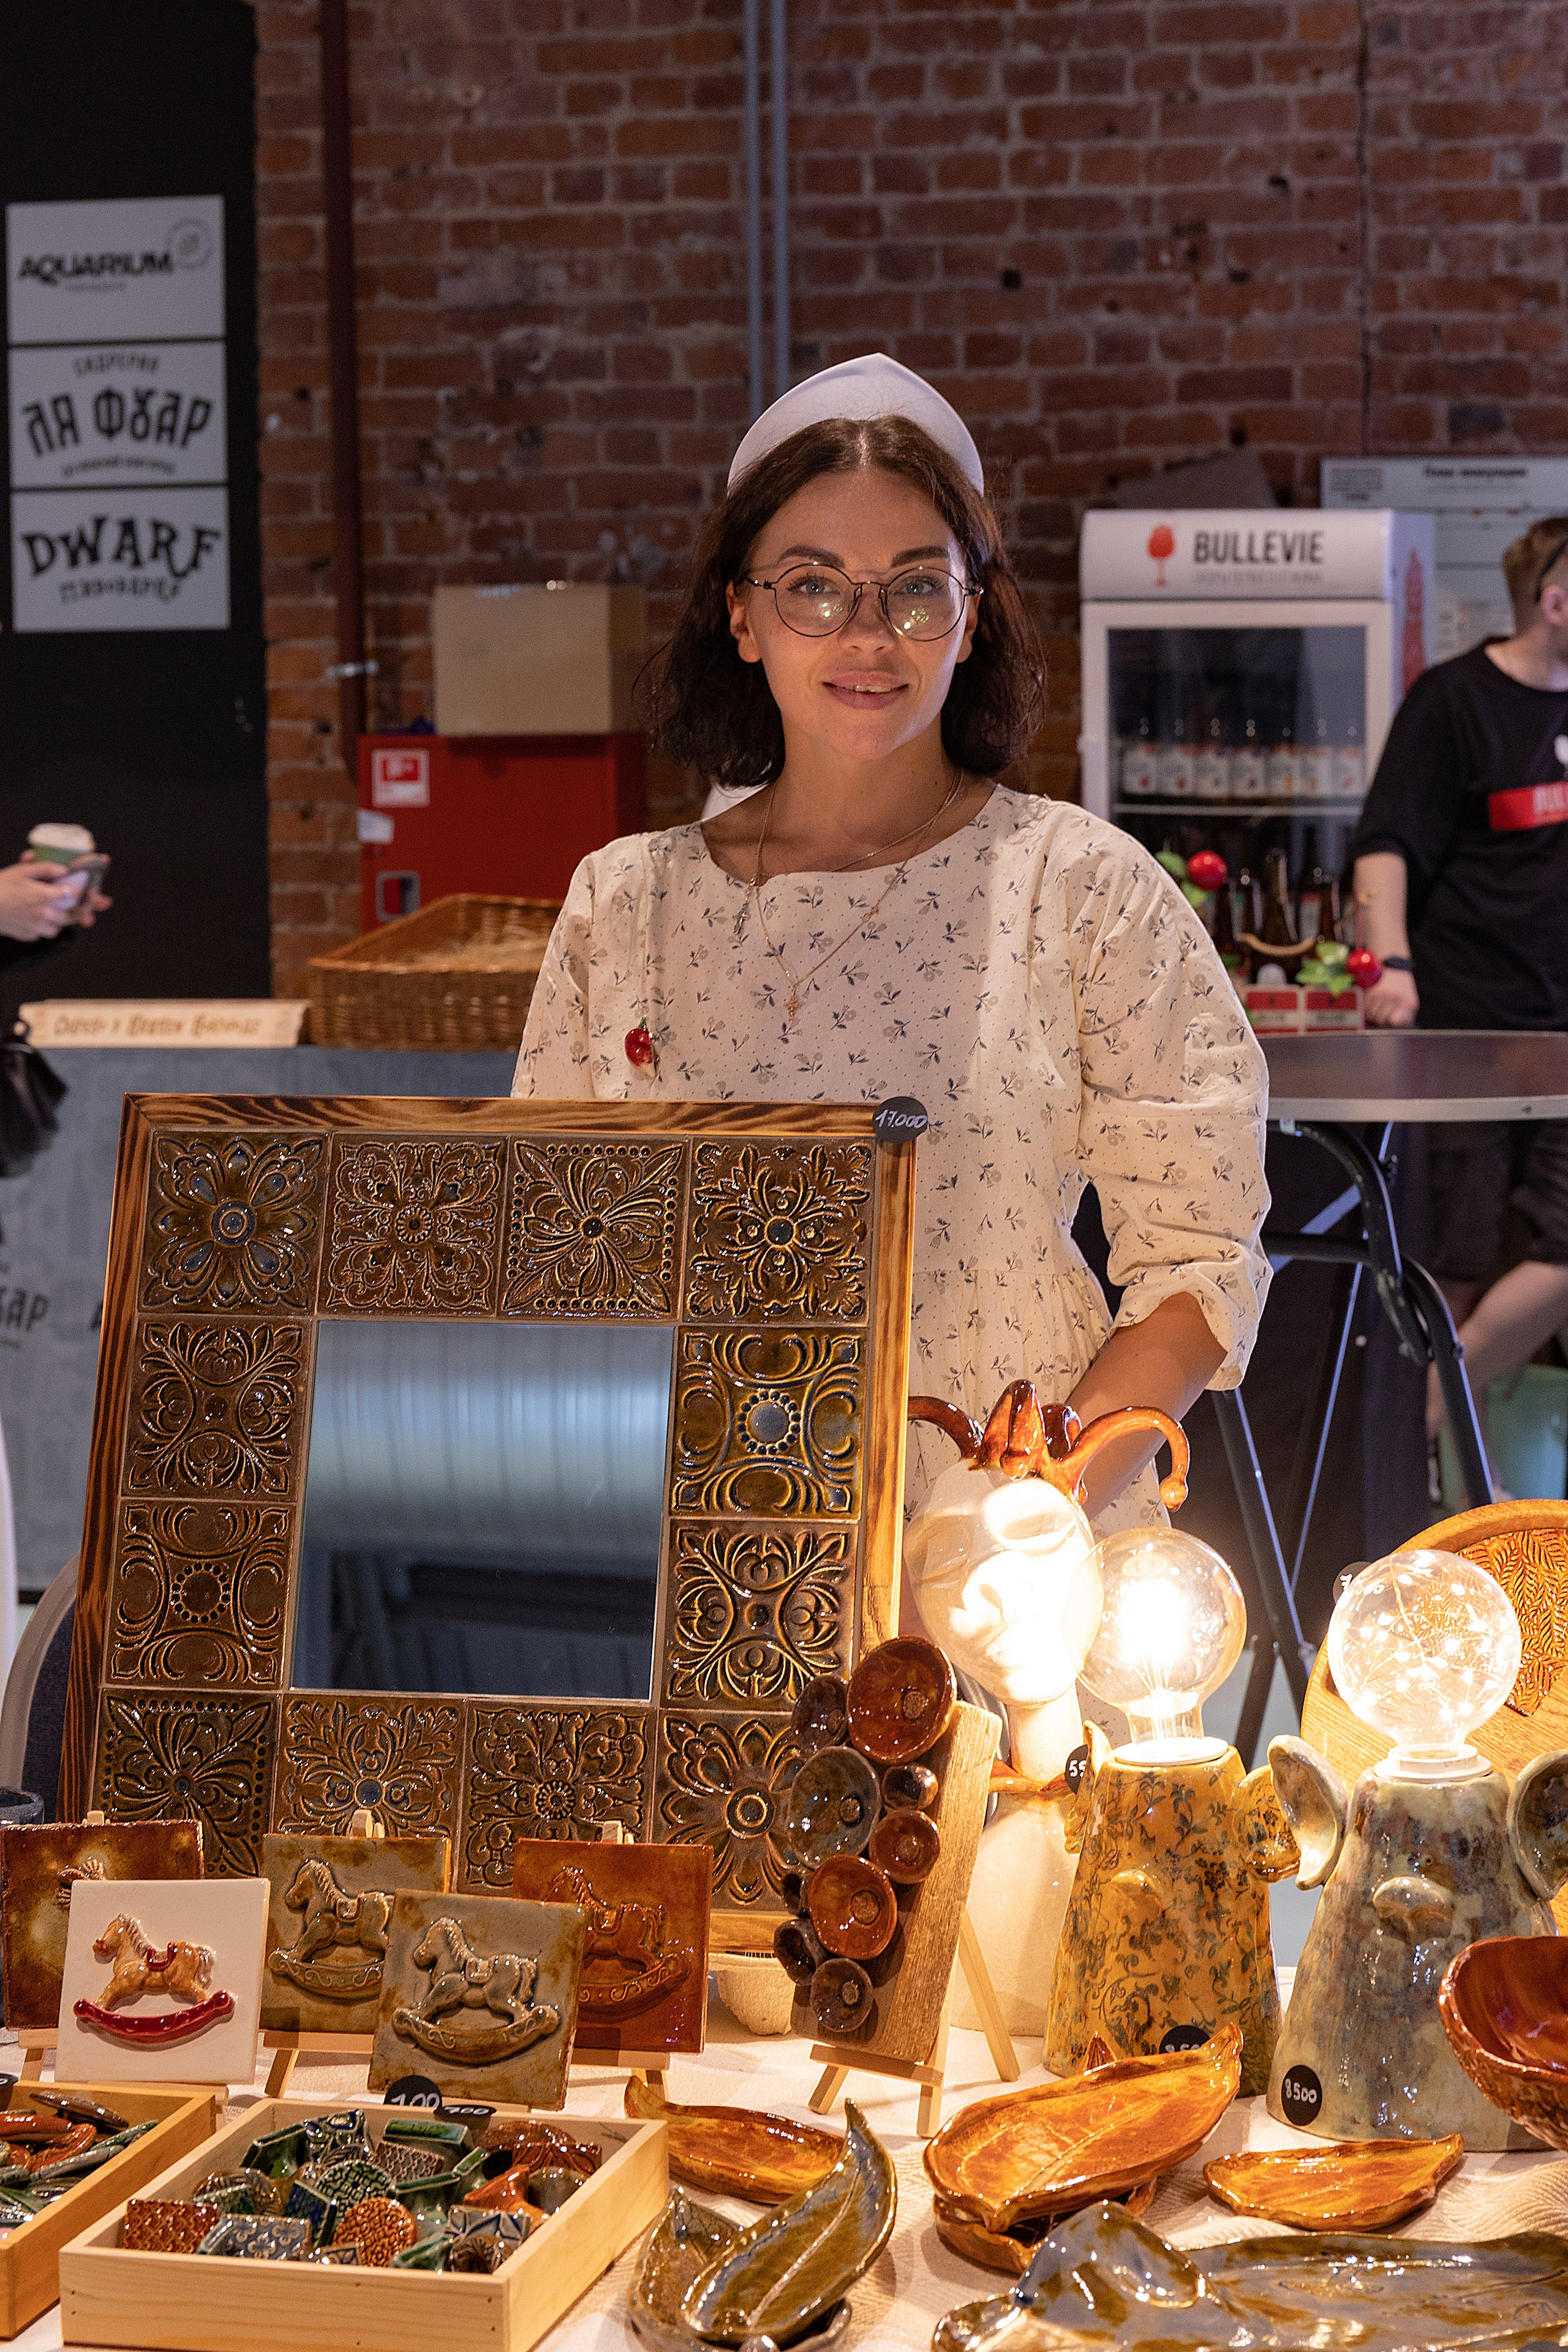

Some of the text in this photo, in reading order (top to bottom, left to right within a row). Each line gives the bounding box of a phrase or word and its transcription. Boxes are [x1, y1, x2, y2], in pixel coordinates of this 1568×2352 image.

[18, 252, 174, 287] AQUARIUM
[21, 516, 221, 578] DWARF
[1193, 530, 1325, 564] BULLEVIE
[1285, 2078, 1317, 2104] 8500
